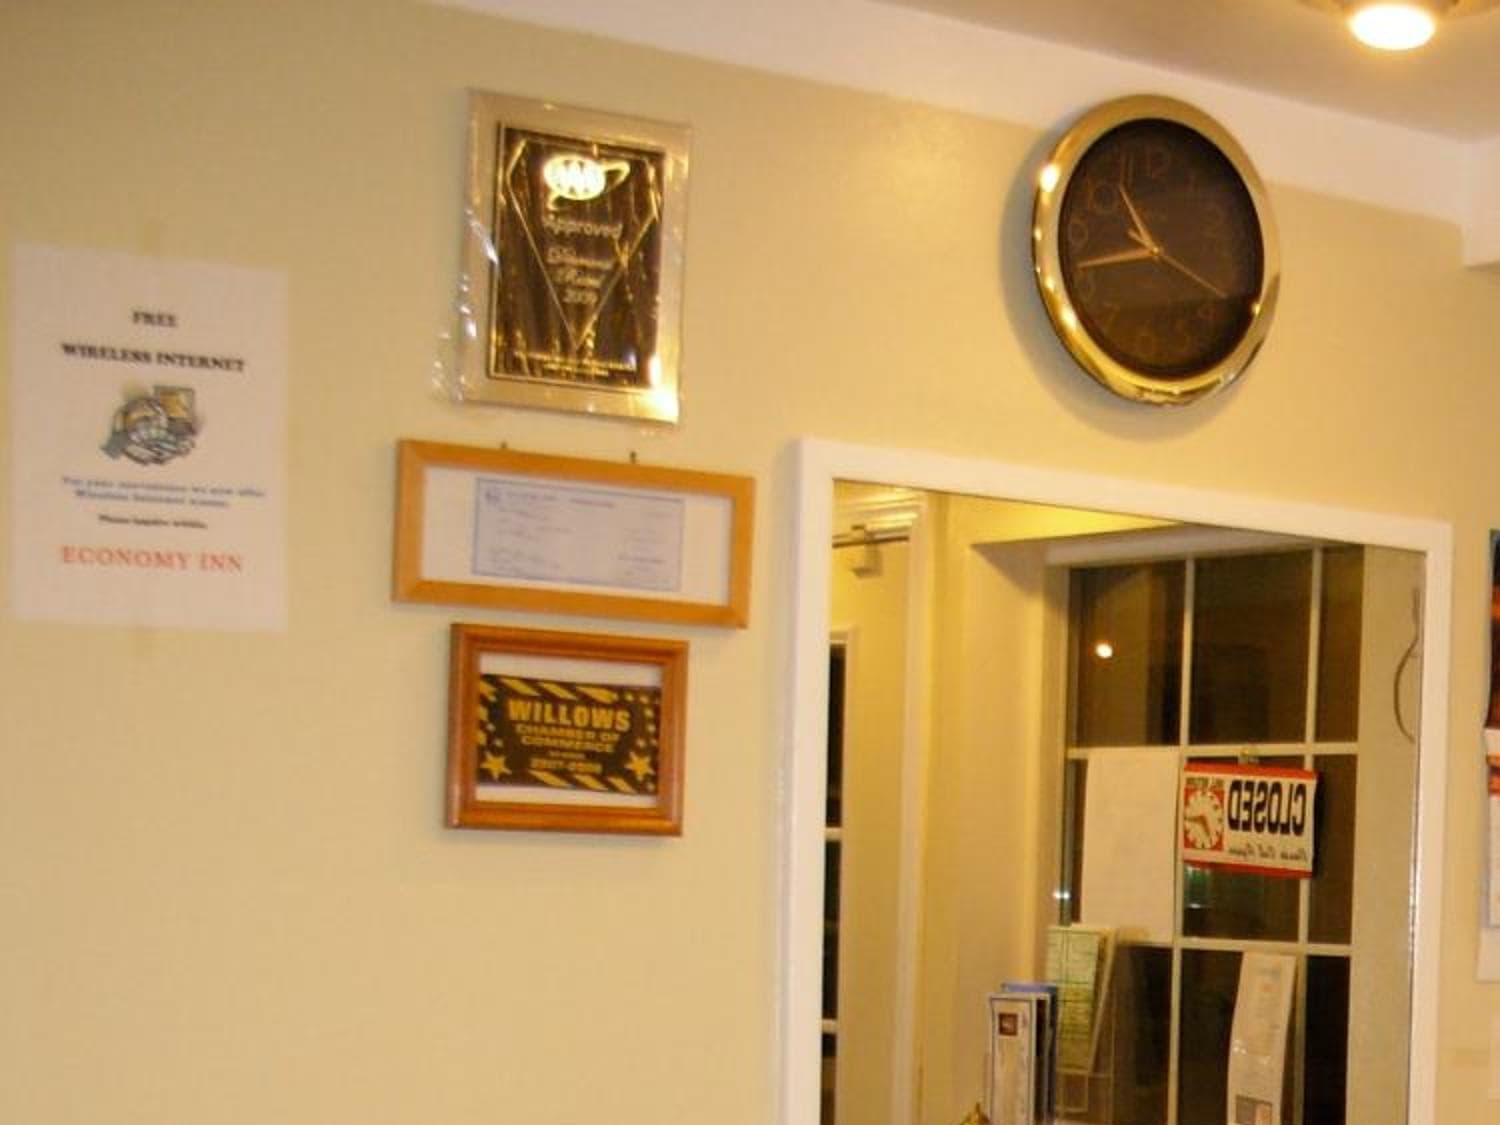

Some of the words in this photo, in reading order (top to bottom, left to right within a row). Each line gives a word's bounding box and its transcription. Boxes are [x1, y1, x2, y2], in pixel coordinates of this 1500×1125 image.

[133, 311, 177, 327] FREE
[61, 342, 152, 364] WIRELESS
[156, 351, 245, 372] INTERNET
[63, 546, 189, 569] ECONOMY
[201, 551, 242, 571] INN
[508, 699, 632, 732] WILLOWS
[515, 723, 596, 740] CHAMBER
[520, 735, 615, 753] COMMERCE
